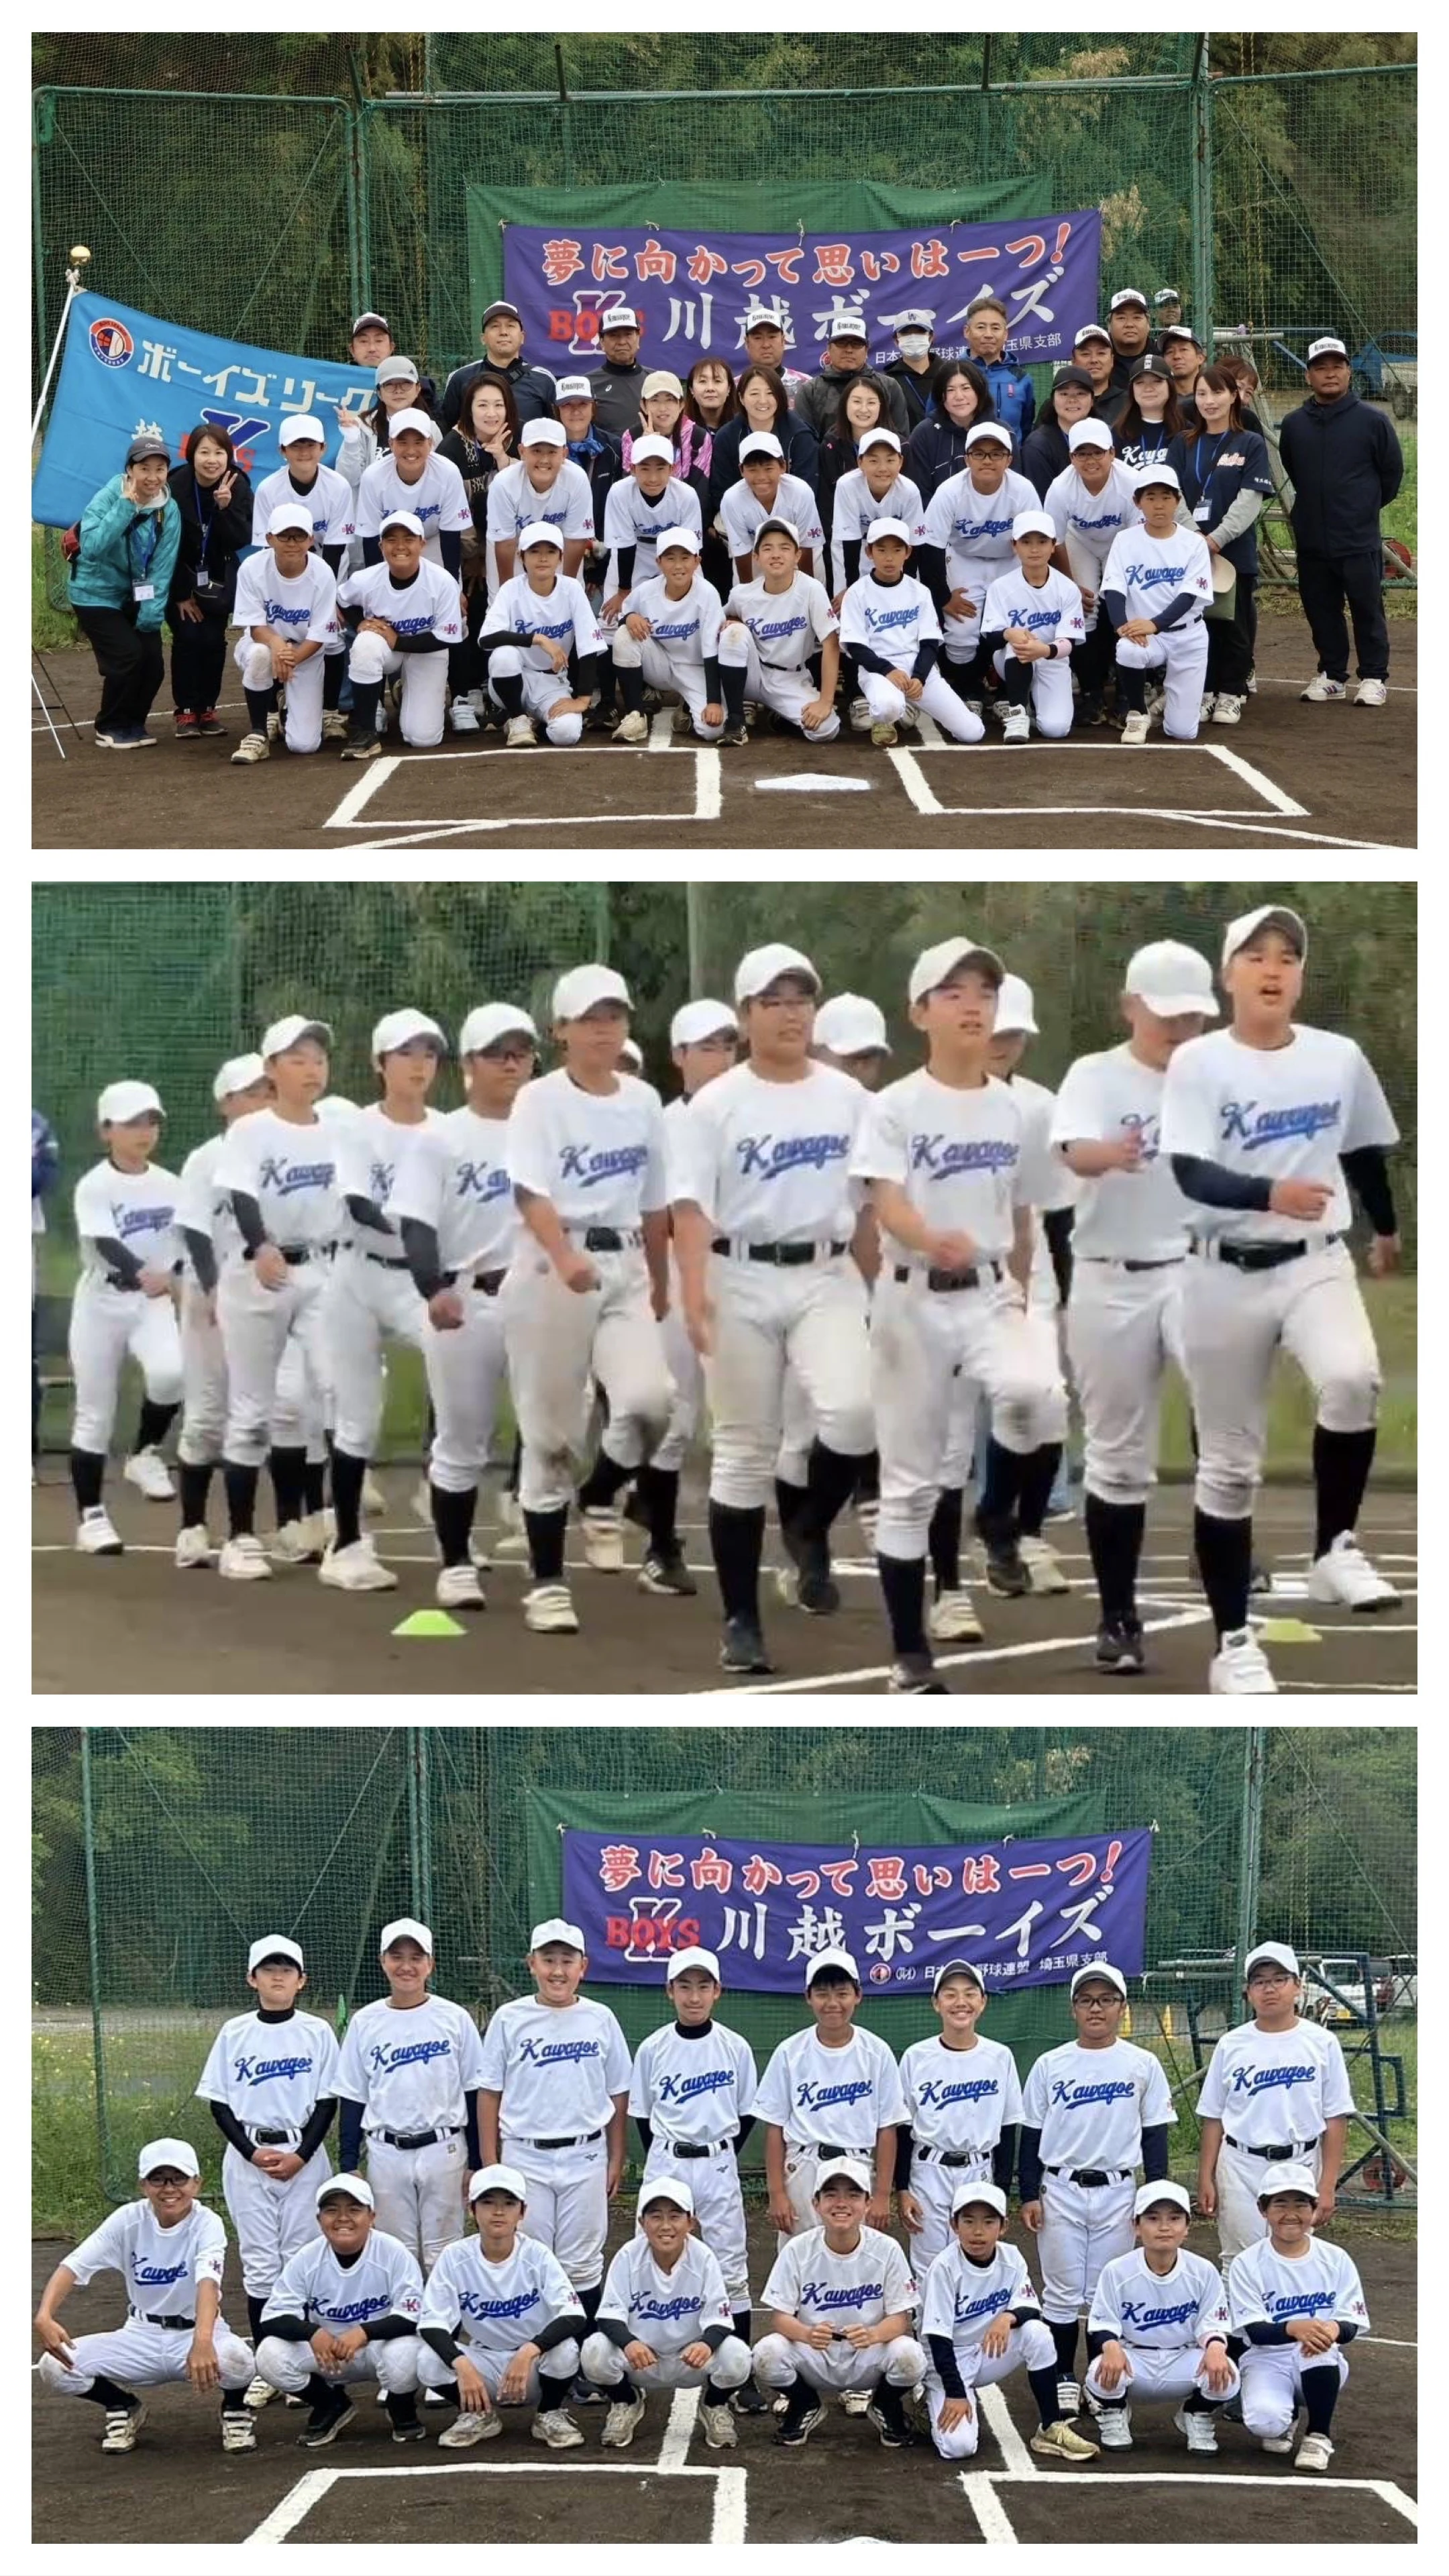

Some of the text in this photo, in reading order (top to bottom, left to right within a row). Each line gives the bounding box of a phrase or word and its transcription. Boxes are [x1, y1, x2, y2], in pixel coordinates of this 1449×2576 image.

[549, 310, 647, 340] BO
[1002, 333, 1062, 352] 玉県支部
[745, 618, 807, 641] Kawagoe
[606, 1915, 702, 1951] BOYS
[716, 1885, 1115, 1962] 川越ボーイズ
[370, 2040, 449, 2074] Kawagoe
[520, 2038, 600, 2068] Kawagoe
[659, 2070, 735, 2105] Kawagoe
[918, 2080, 999, 2110] Kawagoe
[1052, 2080, 1135, 2110] Kawagoe
[1232, 2065, 1315, 2096] Kawagoe
[310, 2294, 391, 2323] Kawagoe
[802, 2283, 883, 2312] Kawagoe
